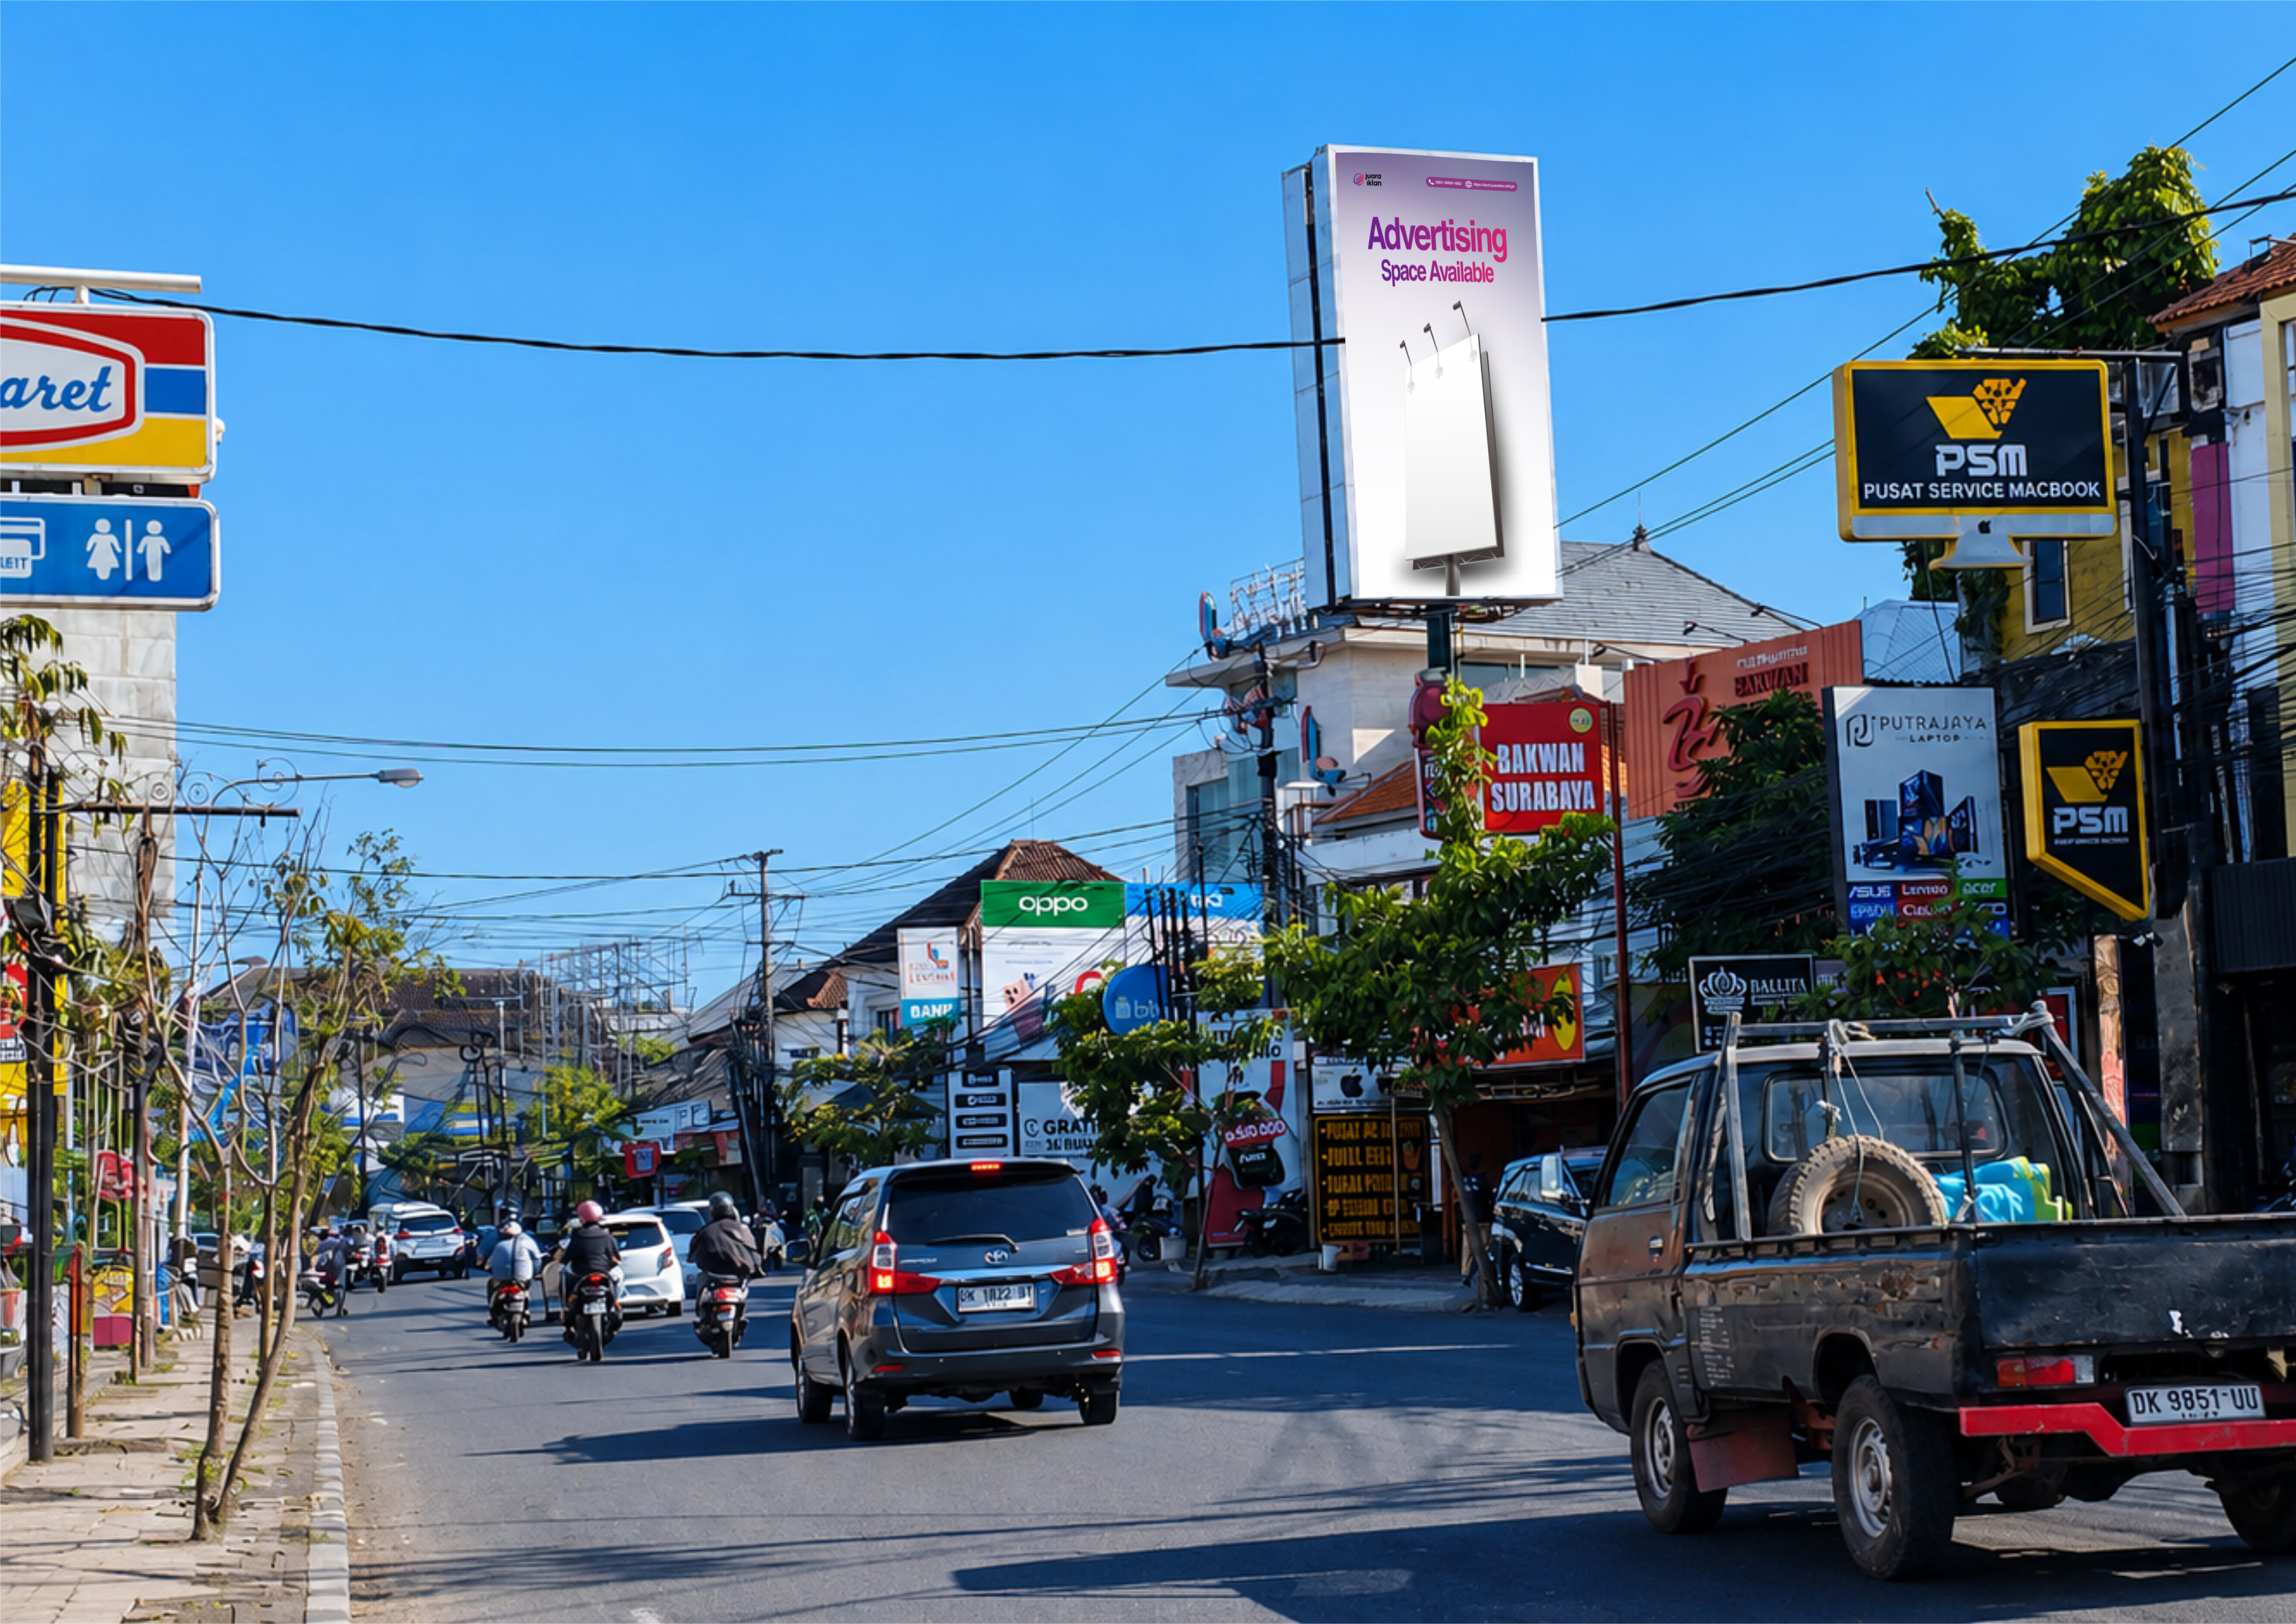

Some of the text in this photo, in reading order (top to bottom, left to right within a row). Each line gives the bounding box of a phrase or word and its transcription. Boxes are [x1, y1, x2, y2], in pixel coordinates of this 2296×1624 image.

[1368, 217, 1508, 262] Advertising
[1381, 259, 1494, 287] Space Available
[1935, 444, 2028, 476] PSM
[1864, 481, 2100, 500] PUSAT SERVICE MACBOOK
[1880, 716, 1986, 730] PUTRAJAYA
[1497, 743, 1585, 774] BAKWAN
[1491, 781, 1596, 812] SURABAYA
[2053, 806, 2128, 835] PSM
[2132, 1392, 2161, 1414] DK
